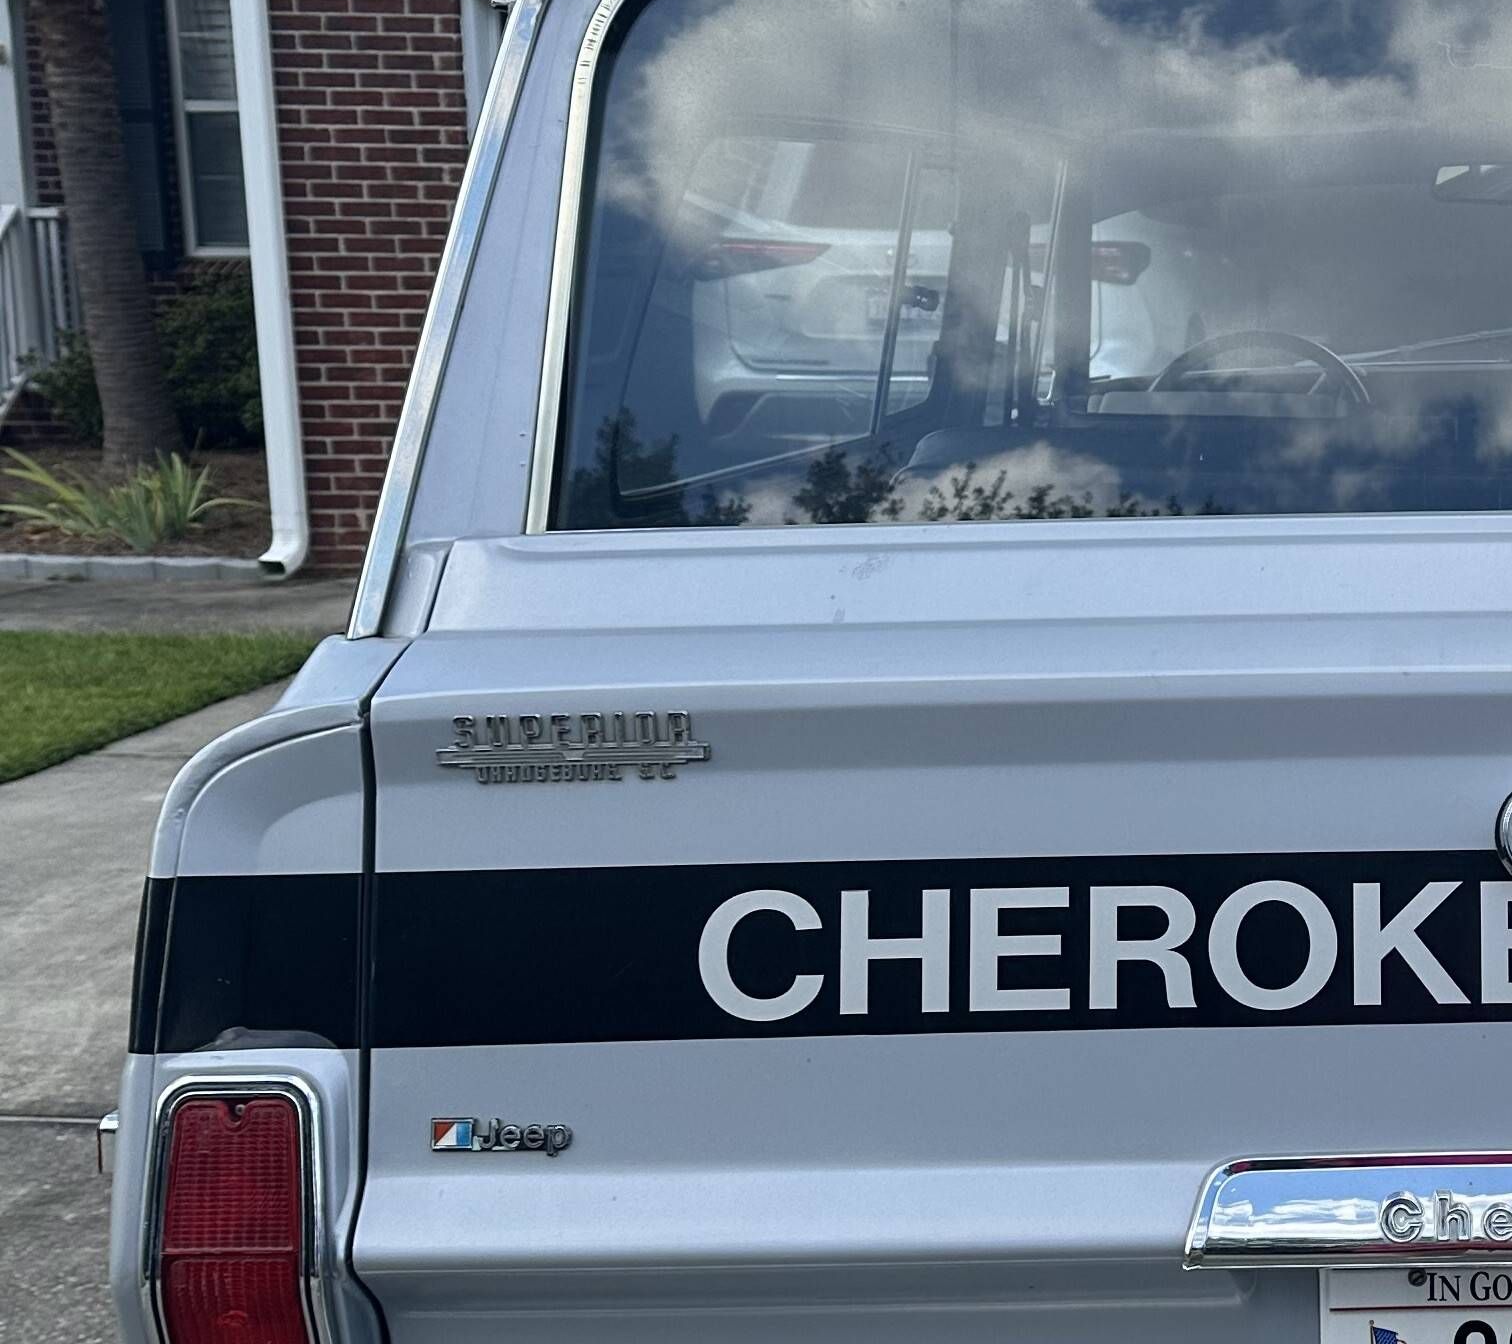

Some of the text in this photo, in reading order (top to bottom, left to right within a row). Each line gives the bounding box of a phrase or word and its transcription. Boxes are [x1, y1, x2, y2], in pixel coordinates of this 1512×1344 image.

[453, 711, 692, 748] SUPERIOR
[471, 1117, 574, 1158] Jeep
[1427, 1271, 1461, 1302] IN
